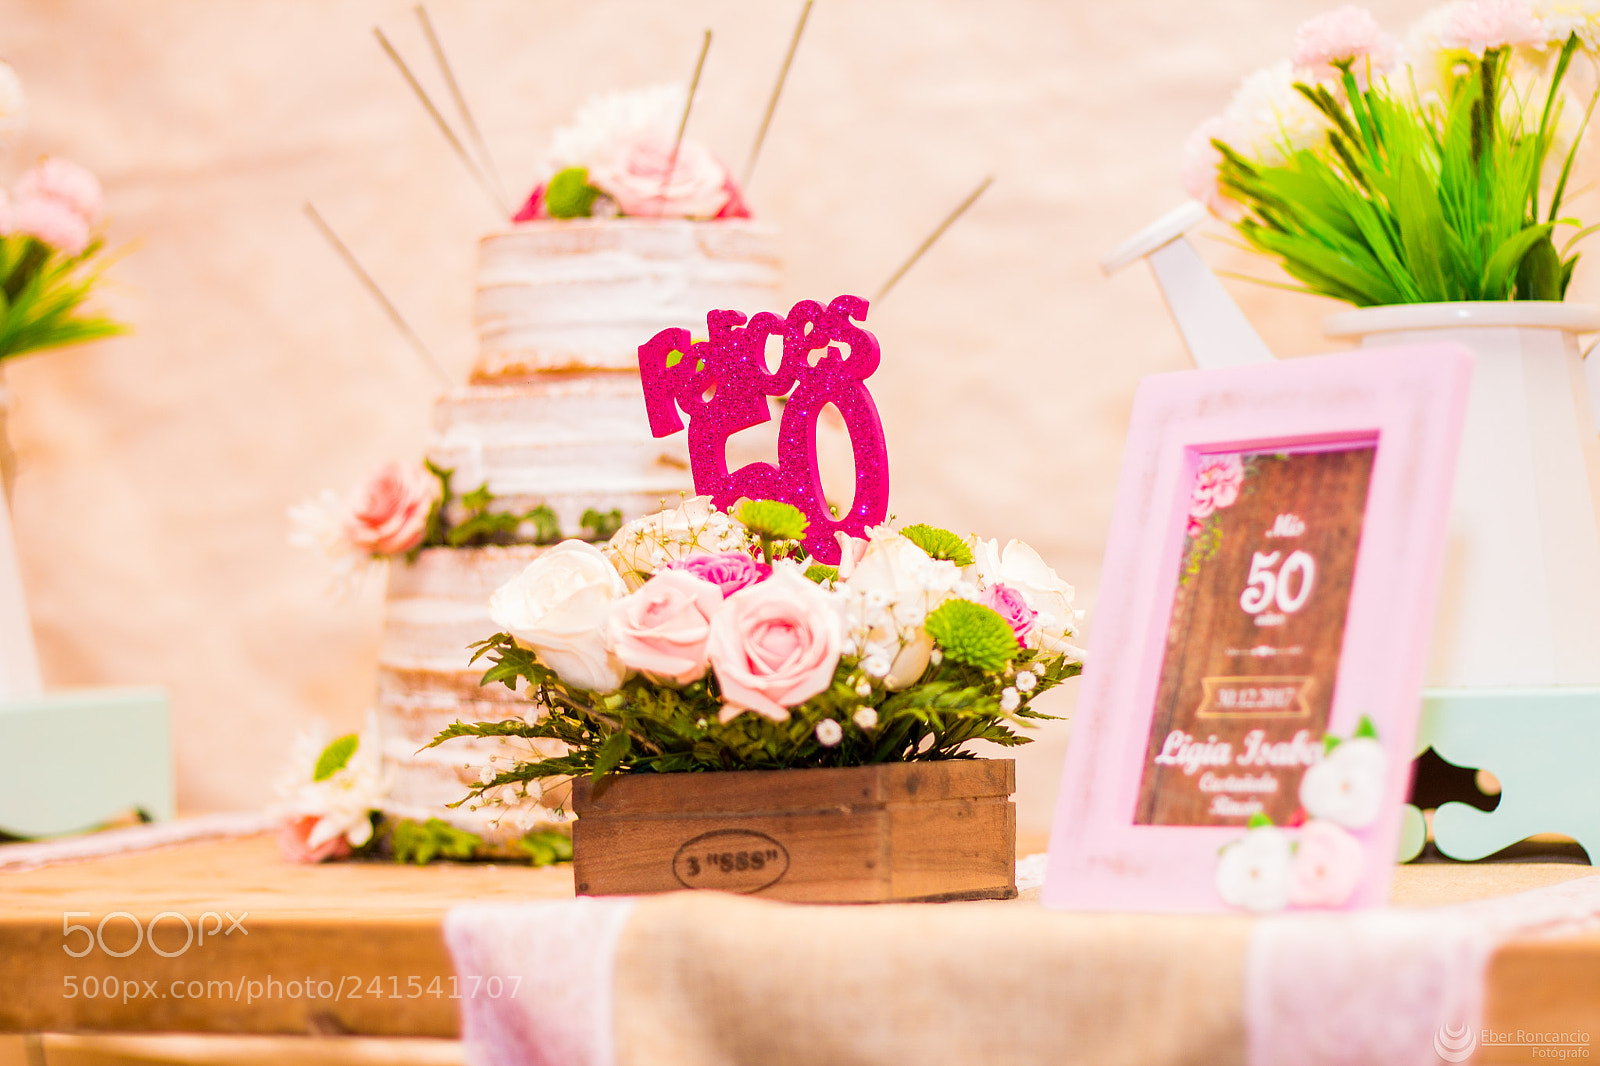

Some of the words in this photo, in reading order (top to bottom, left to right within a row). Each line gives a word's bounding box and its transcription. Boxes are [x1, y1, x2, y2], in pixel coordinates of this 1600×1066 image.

[688, 382, 890, 566] 50
[1239, 550, 1315, 614] 50
[1154, 729, 1231, 775] Ligia
[686, 856, 701, 877] 3
